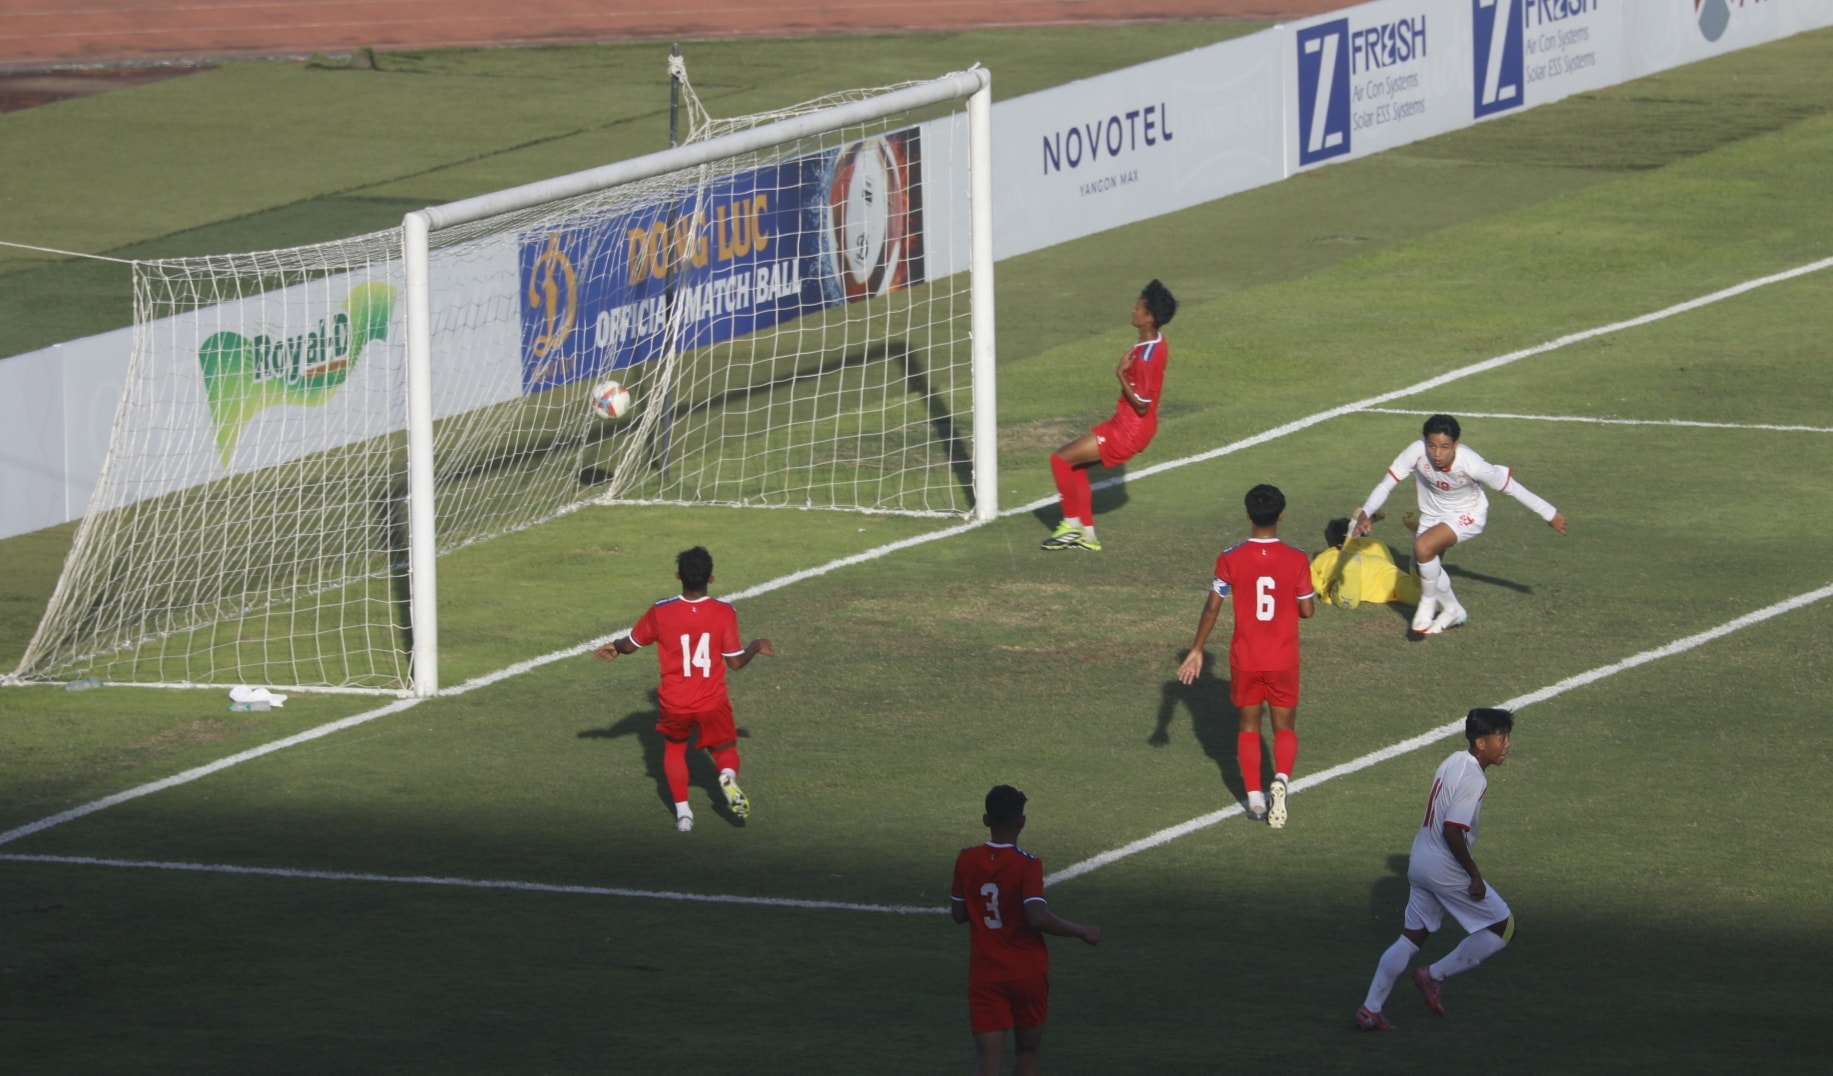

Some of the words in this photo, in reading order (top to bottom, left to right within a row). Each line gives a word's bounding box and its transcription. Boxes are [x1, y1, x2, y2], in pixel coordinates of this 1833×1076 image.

[1352, 14, 1427, 75] FRESH
[1525, 39, 1537, 56] Air
[1540, 33, 1556, 53] Con
[1557, 26, 1589, 53] Systems
[1352, 85, 1364, 103] Air
[1366, 80, 1384, 100] Con
[1385, 73, 1419, 100] Systems
[1526, 65, 1546, 84] Solar
[1548, 57, 1562, 77] ESS
[1564, 51, 1596, 76] Systems
[1043, 102, 1174, 175] NOVOTEL
[1352, 111, 1374, 132] Solar
[1376, 103, 1391, 125] ESS
[1392, 99, 1425, 123] Systems
[1079, 176, 1118, 198] YANGON
[1120, 169, 1140, 186] MAX
[627, 211, 709, 287] DONG
[716, 193, 770, 263] LUC
[596, 293, 679, 349] OFFICIA
[684, 271, 751, 324] MATCH
[755, 258, 802, 305] BALL
[1256, 575, 1276, 622] 6
[680, 632, 712, 678] 14
[980, 882, 1003, 930] 3
